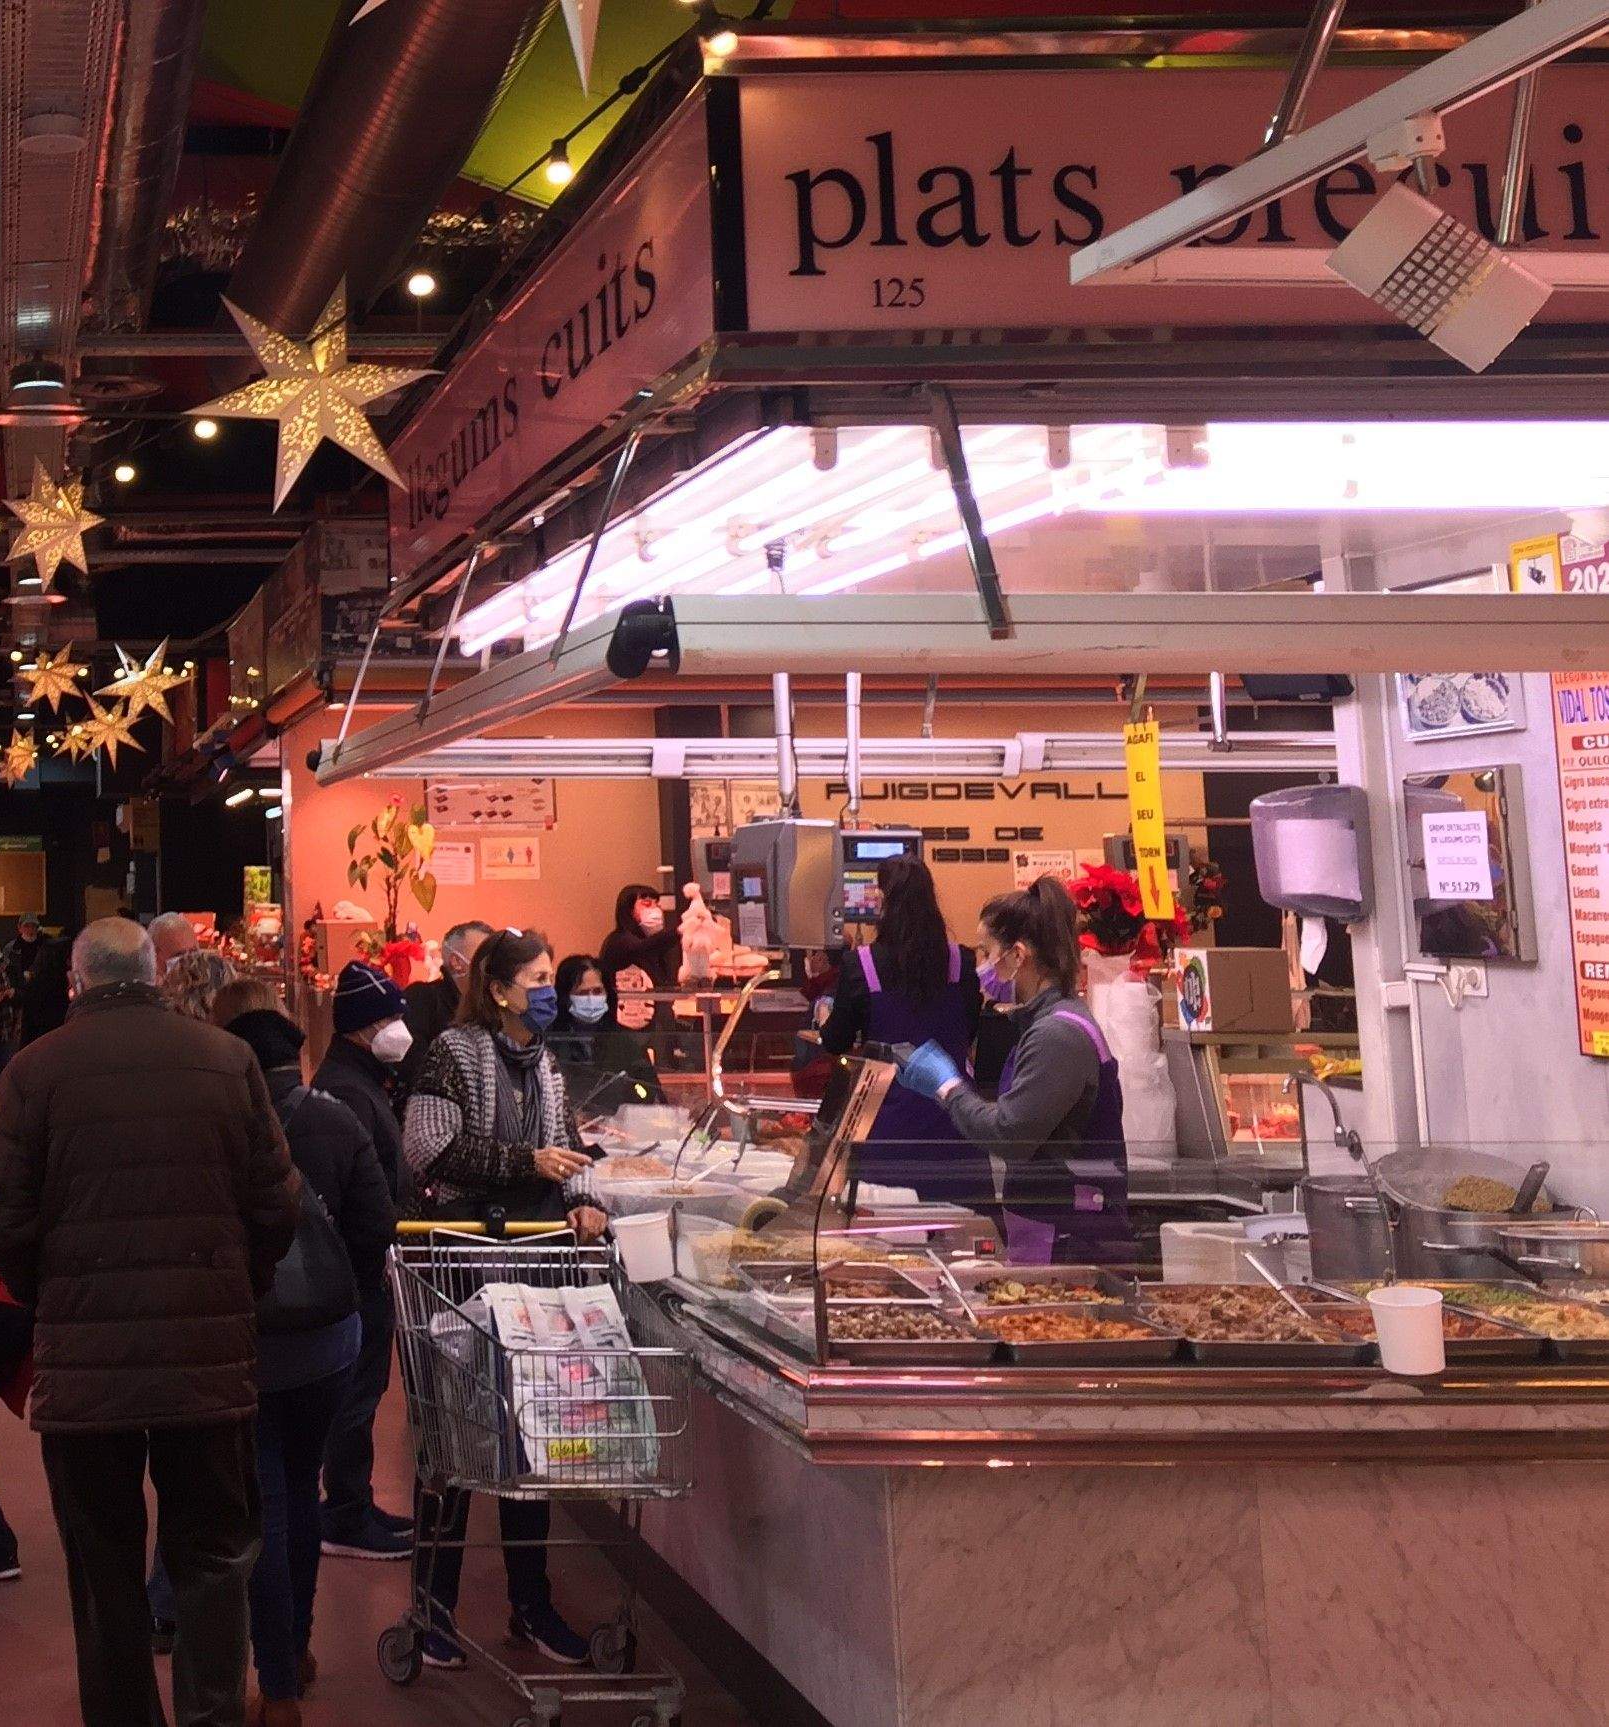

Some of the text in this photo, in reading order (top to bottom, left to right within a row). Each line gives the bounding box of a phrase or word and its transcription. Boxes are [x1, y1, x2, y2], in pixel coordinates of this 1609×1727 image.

[786, 122, 1601, 276] plats preui
[873, 278, 926, 308] 125
[408, 239, 657, 530] llegums cuits
[1557, 687, 1589, 724] VIDAL
[1126, 733, 1154, 745] AGAFI
[1135, 772, 1146, 783] EL
[1137, 809, 1154, 820] SEU
